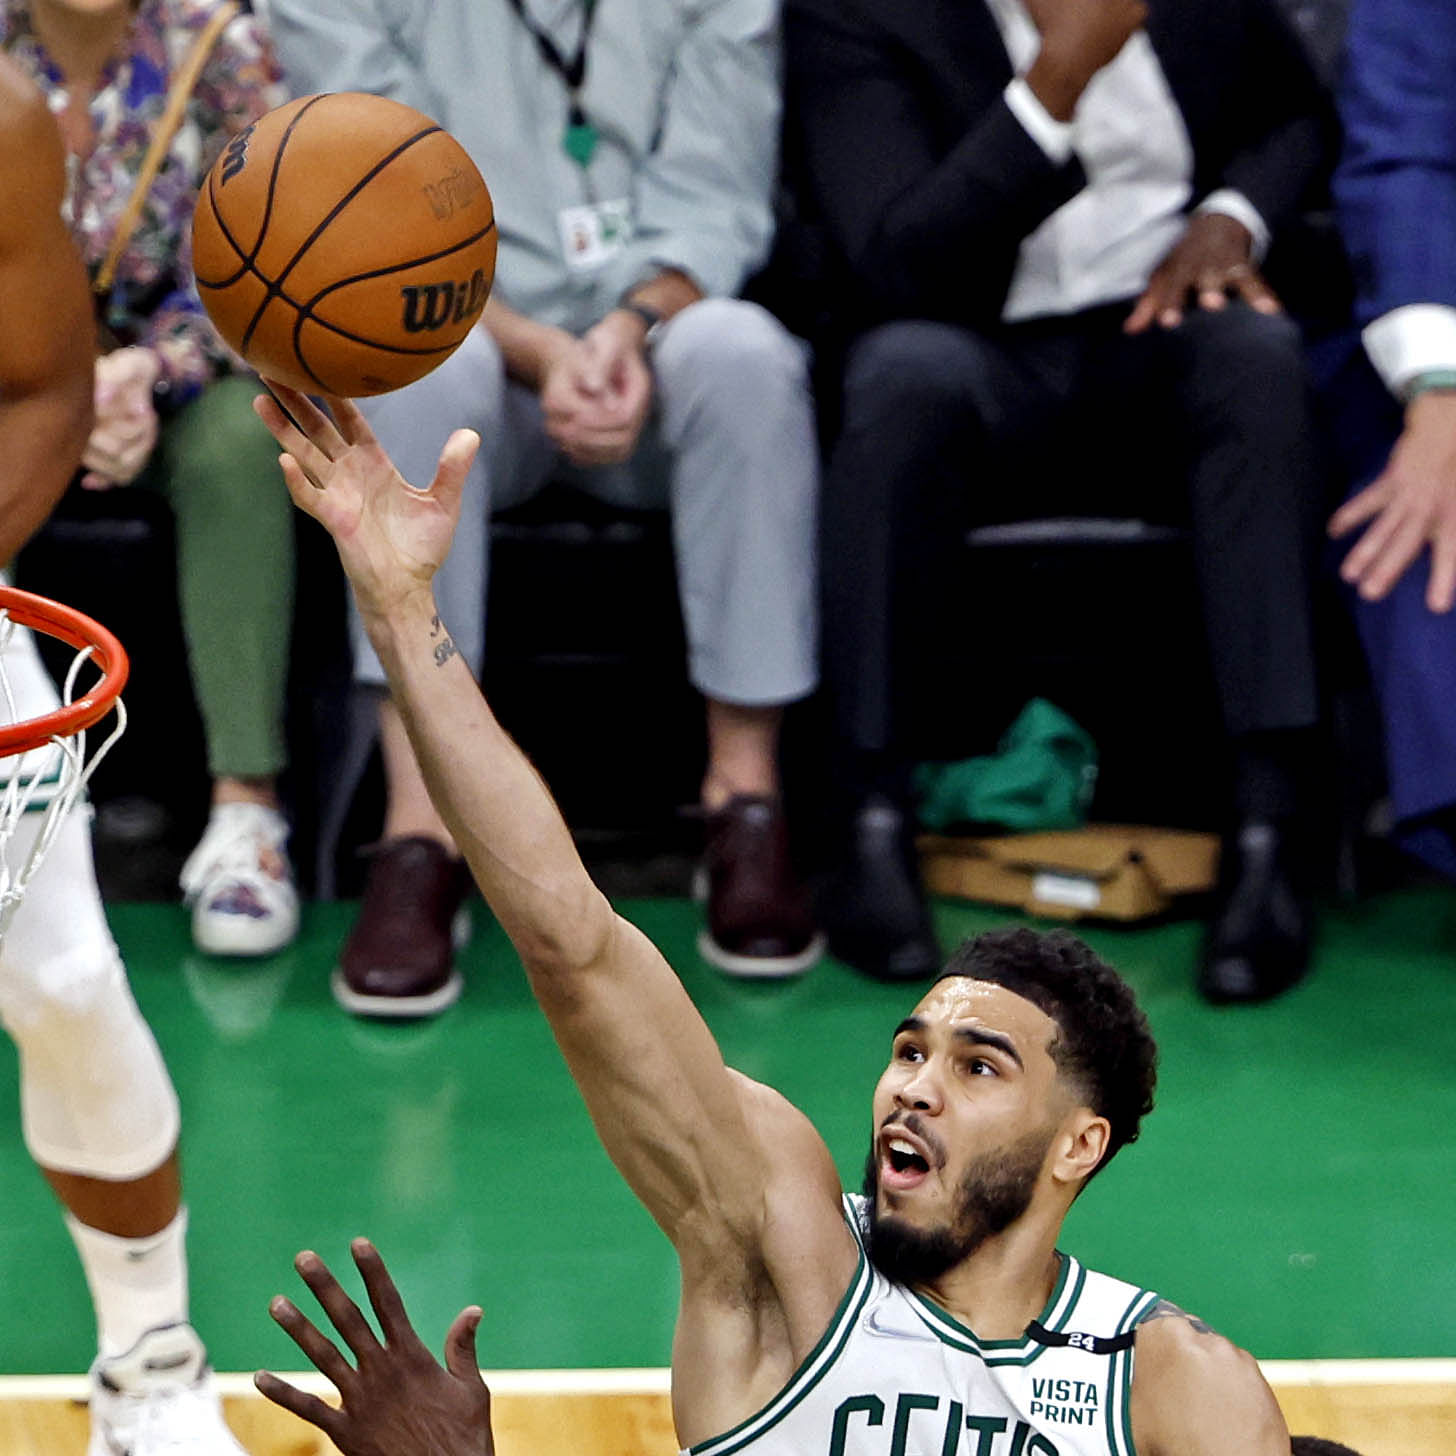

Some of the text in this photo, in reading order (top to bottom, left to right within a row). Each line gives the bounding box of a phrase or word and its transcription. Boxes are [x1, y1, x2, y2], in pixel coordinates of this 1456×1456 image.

[1067, 1332, 1096, 1351] 24
[1032, 1377, 1098, 1406] VISTA
[1030, 1400, 1098, 1426] PRINT
